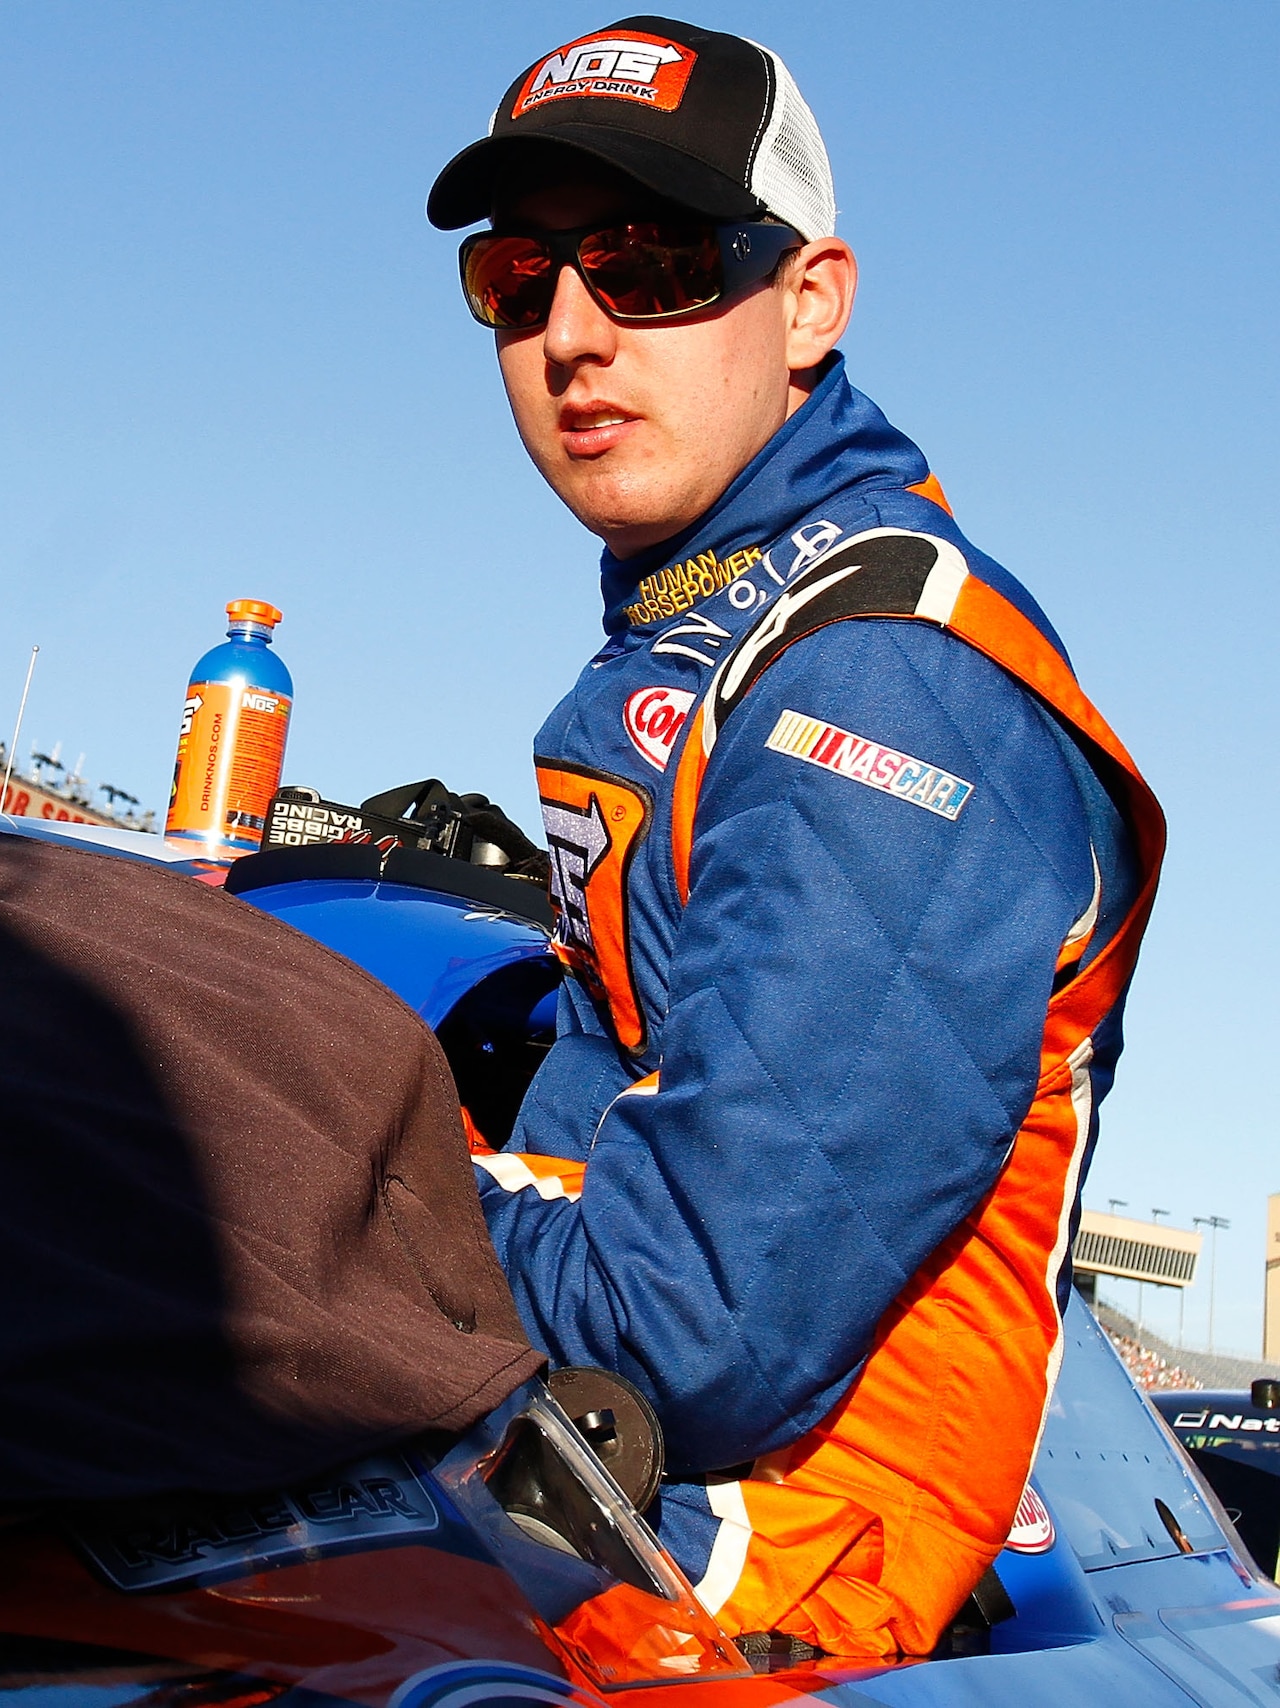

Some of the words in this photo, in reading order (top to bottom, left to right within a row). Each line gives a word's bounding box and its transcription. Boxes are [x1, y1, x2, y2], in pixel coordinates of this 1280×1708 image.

[530, 40, 668, 93] NOS
[524, 82, 589, 105] ENERGY
[593, 81, 655, 99] DRINK
[638, 549, 718, 601] HUMAN
[242, 692, 279, 714] NOS
[200, 713, 223, 812] DRINKNOS.COM
[828, 736, 957, 811] NASCAR
[271, 816, 344, 841] GIBBS
[273, 802, 363, 831] RACING
[269, 830, 322, 846] JOE
[296, 1477, 424, 1526] CAR
